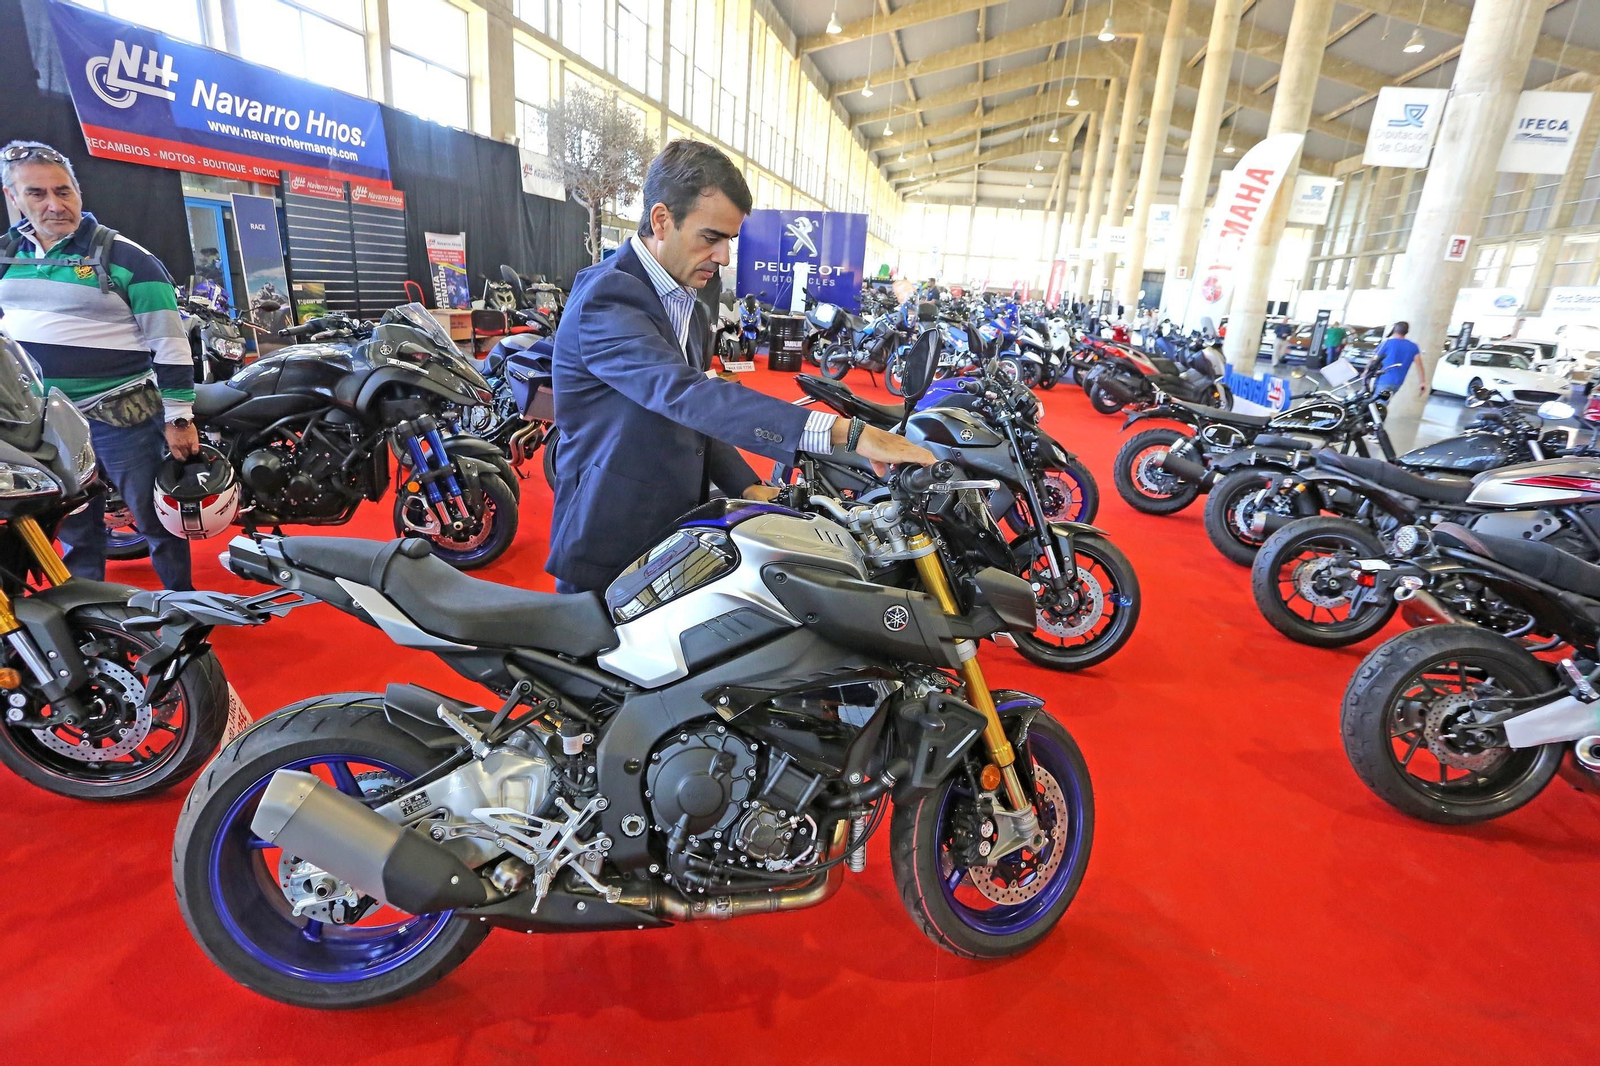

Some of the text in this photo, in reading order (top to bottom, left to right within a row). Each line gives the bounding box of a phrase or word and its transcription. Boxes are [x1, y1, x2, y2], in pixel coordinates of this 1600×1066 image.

[191, 79, 367, 147] Navarro Hnos.
[1518, 118, 1569, 131] IFECA
[207, 120, 359, 161] www.navarrohermanos.com
[85, 136, 151, 157] RECAMBIOS
[159, 150, 196, 165] MOTOS
[203, 158, 247, 174] BOUTIQUE
[250, 223, 266, 231] RACE
[755, 261, 844, 276] PEUEOT
[762, 275, 835, 286] MOTOCLES
[433, 276, 443, 309] ANTIA
